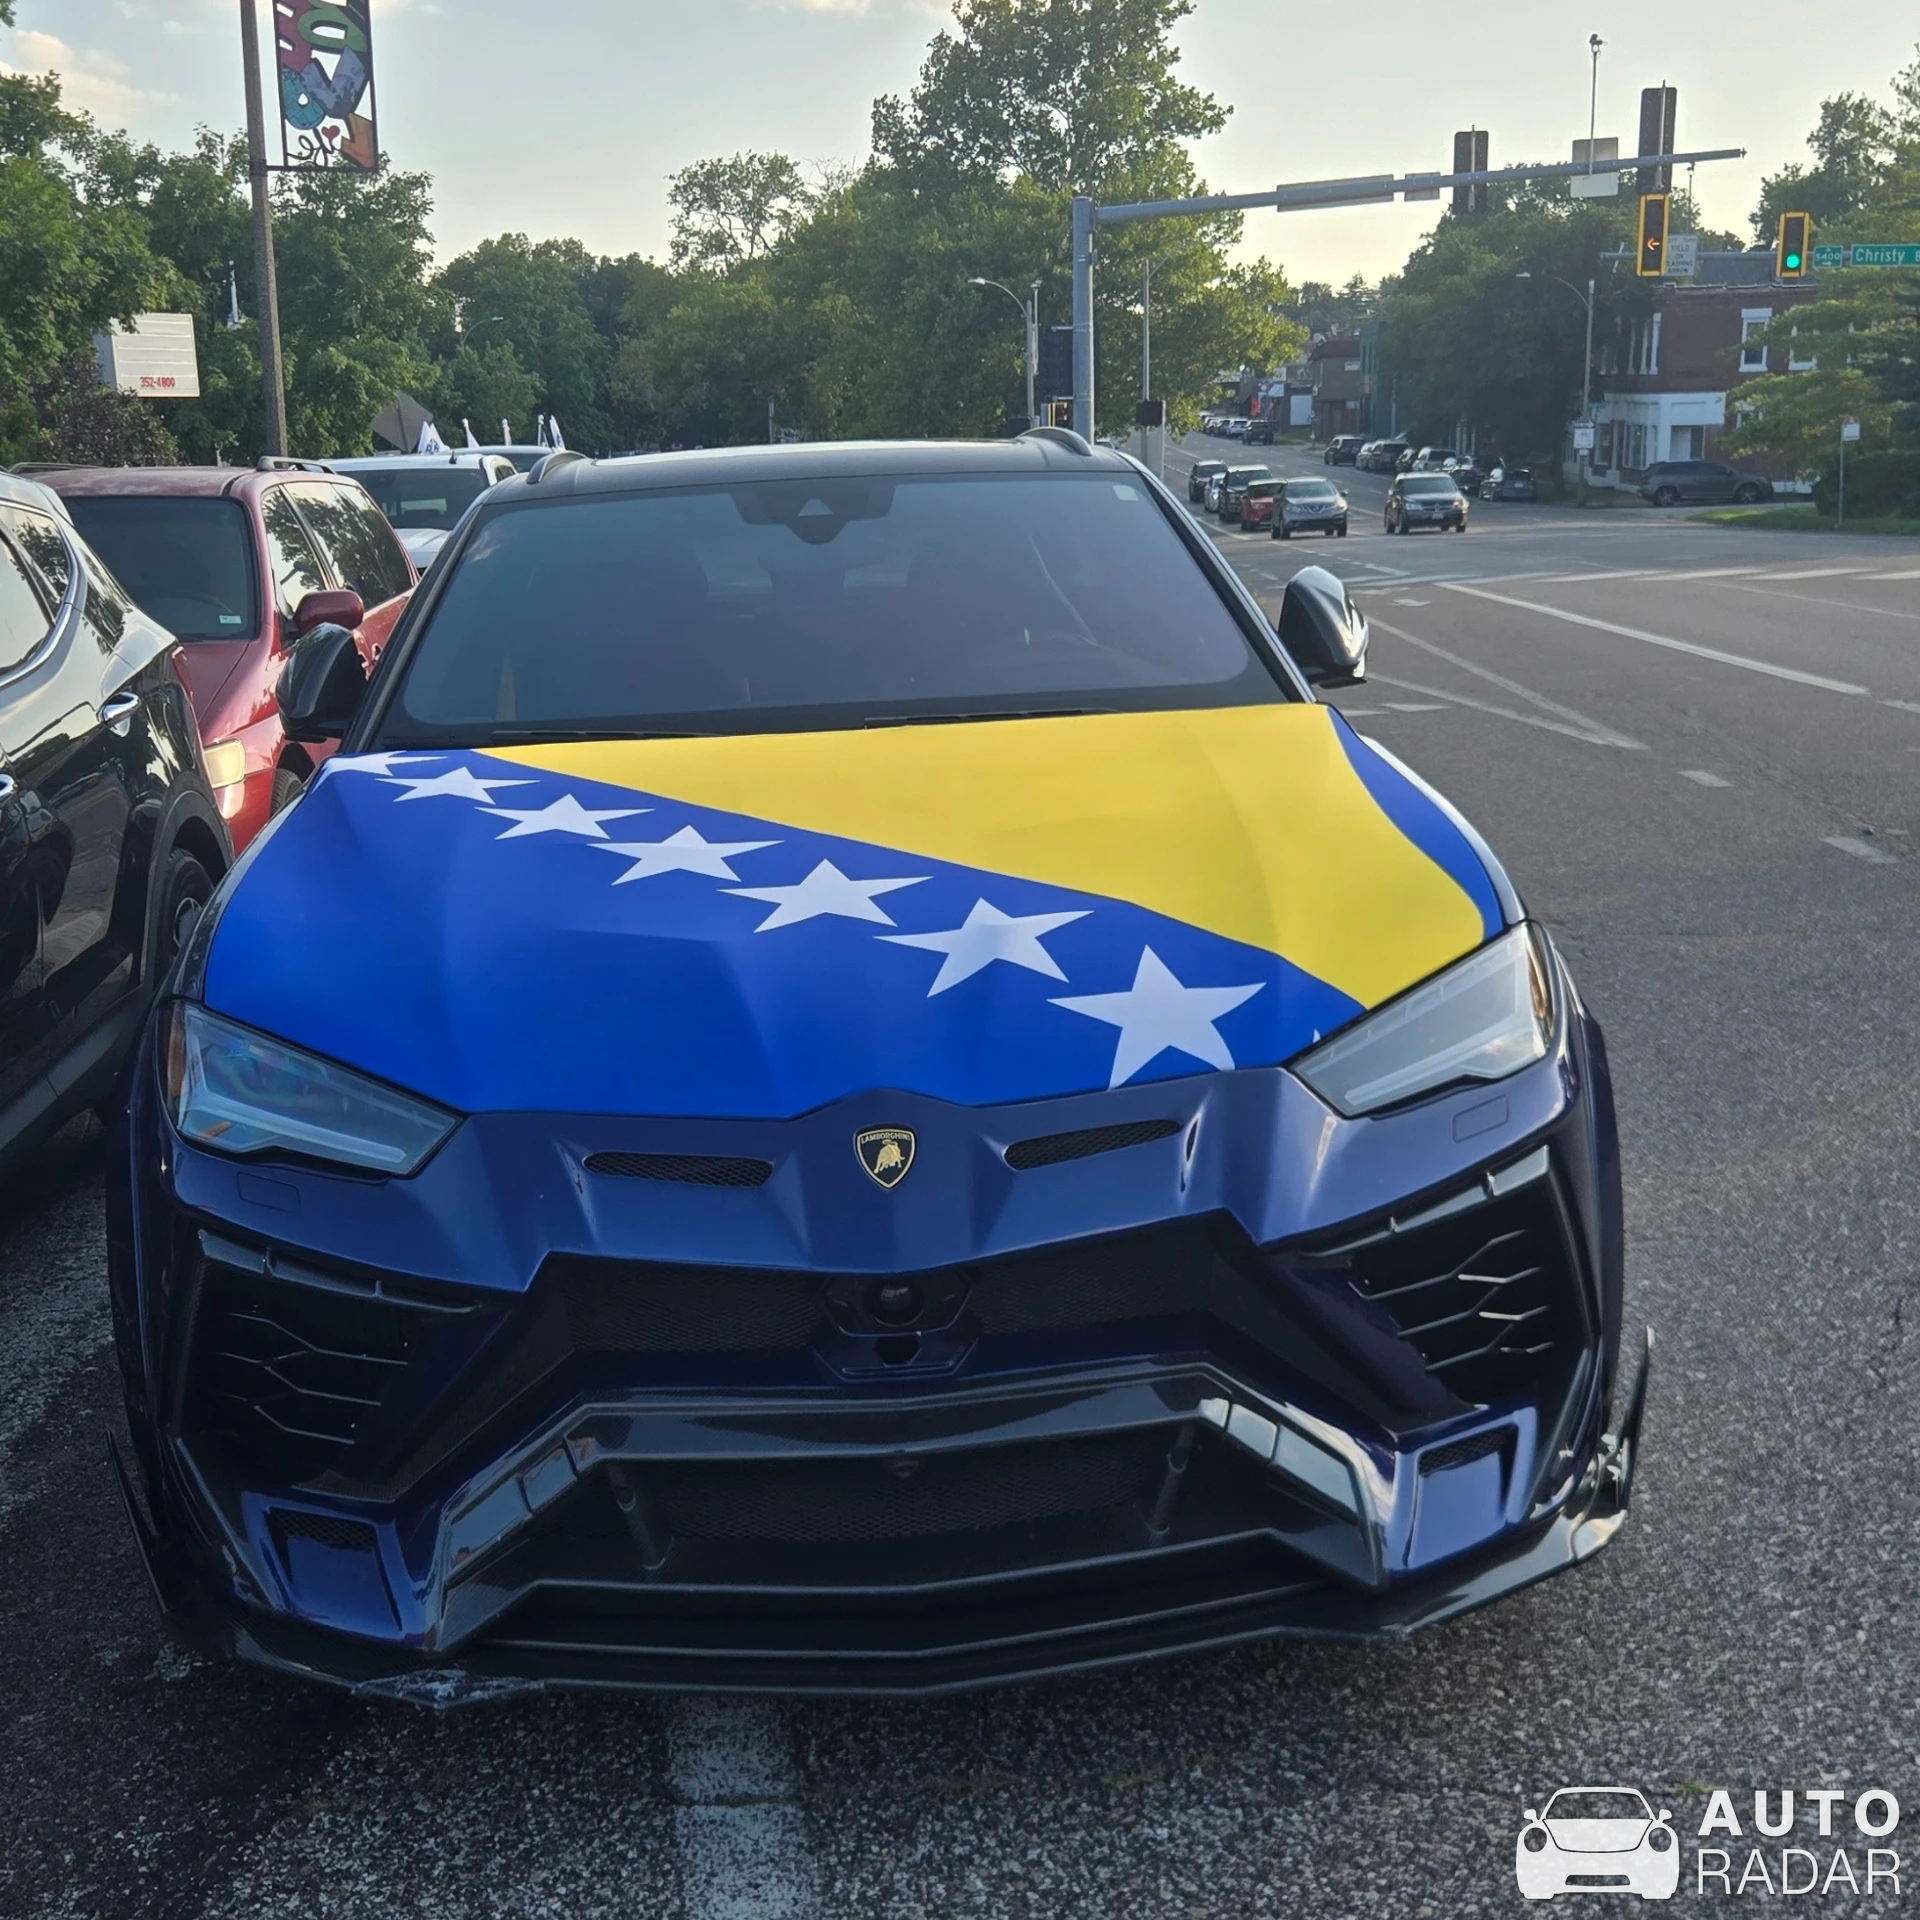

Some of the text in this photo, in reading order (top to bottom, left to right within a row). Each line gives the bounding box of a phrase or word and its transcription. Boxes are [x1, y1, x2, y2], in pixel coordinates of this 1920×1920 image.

[1815, 252, 1840, 260] 5400
[1855, 248, 1905, 265] Christy
[861, 1132, 911, 1144] LAMBORGHINI
